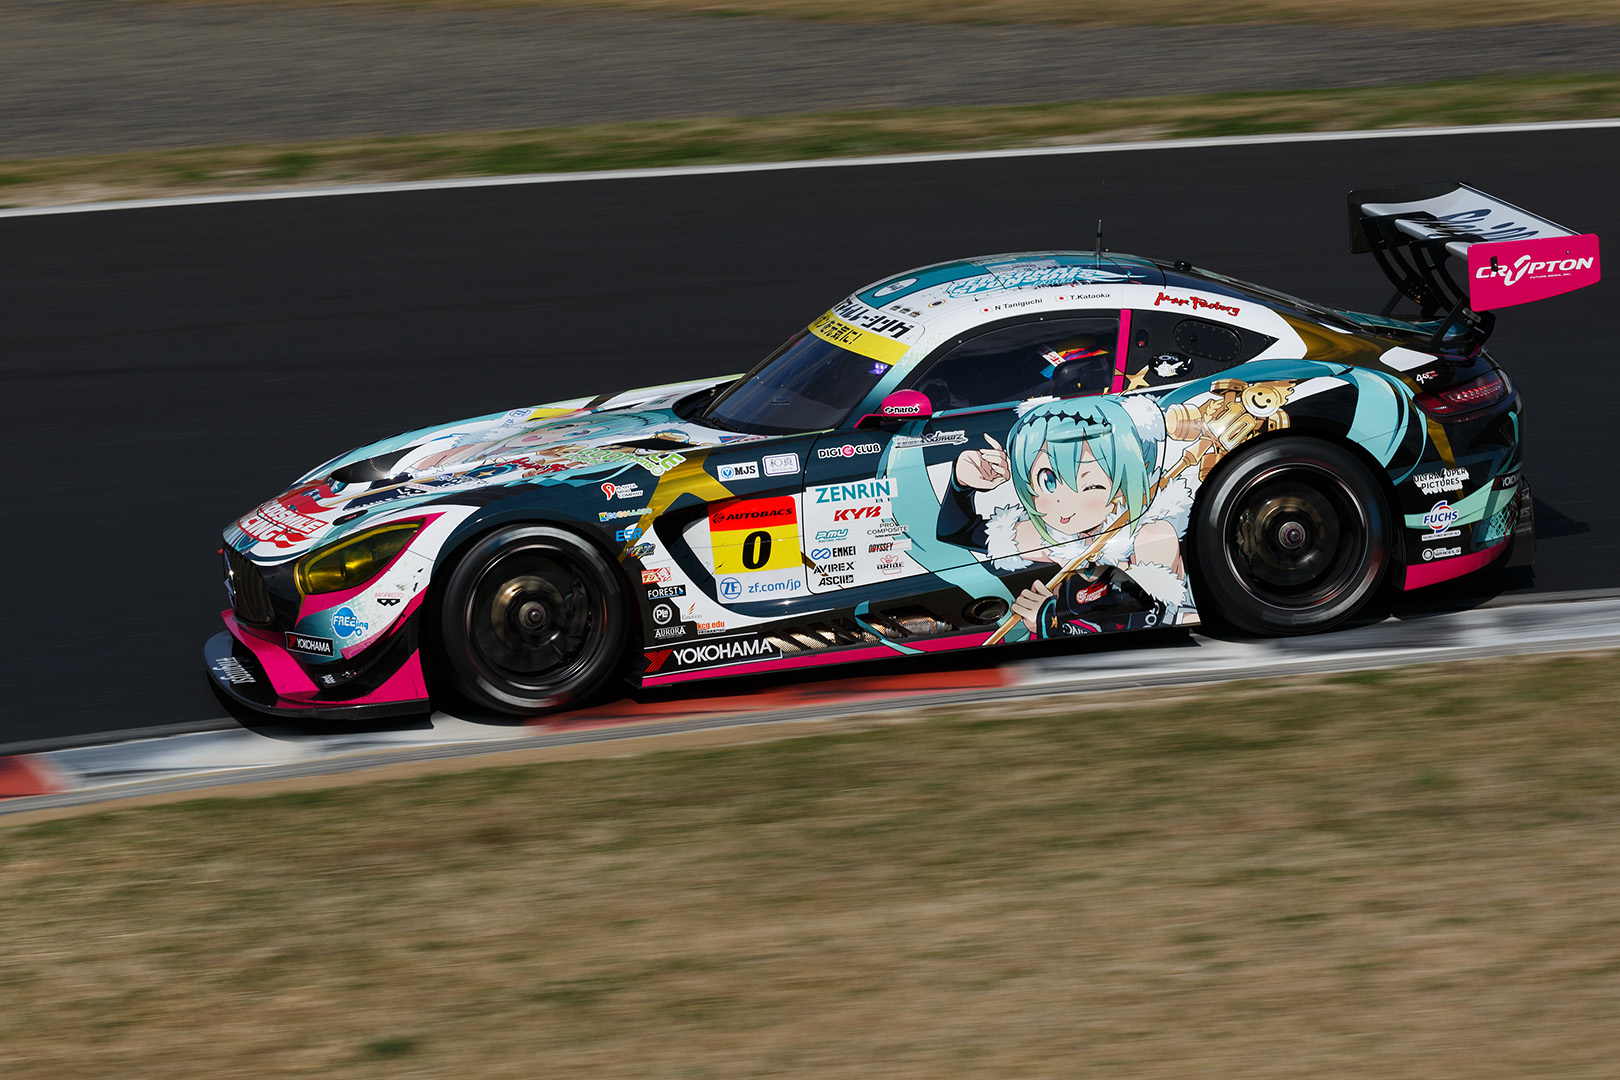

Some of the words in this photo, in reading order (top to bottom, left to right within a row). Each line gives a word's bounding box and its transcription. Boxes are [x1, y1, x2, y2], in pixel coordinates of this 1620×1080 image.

[1069, 292, 1111, 301] T.Kataoka
[1003, 298, 1043, 311] Taniguchi
[1189, 296, 1241, 317] Factory
[819, 449, 842, 458] DIGI
[856, 443, 881, 453] CLUB
[734, 464, 756, 476] MJS
[1421, 477, 1460, 490] PICTURES
[815, 481, 891, 504] ZENRIN
[726, 507, 793, 521] AUTOBACS
[833, 505, 882, 522] KYB
[1423, 511, 1458, 525] FUCHS
[616, 528, 642, 541] ESR
[866, 526, 909, 536] COMPOSITE
[741, 530, 772, 570] 0
[832, 545, 857, 557] ENKEI
[813, 561, 855, 575] AVIREX
[647, 586, 679, 598] FOREST
[723, 581, 741, 595] ZF
[748, 578, 801, 594] zf.com/jp
[333, 614, 369, 630] FREEing
[696, 620, 725, 630] kcg.edu
[296, 637, 332, 653] YOKOHAMA
[673, 638, 773, 666] YOKOHAMA
